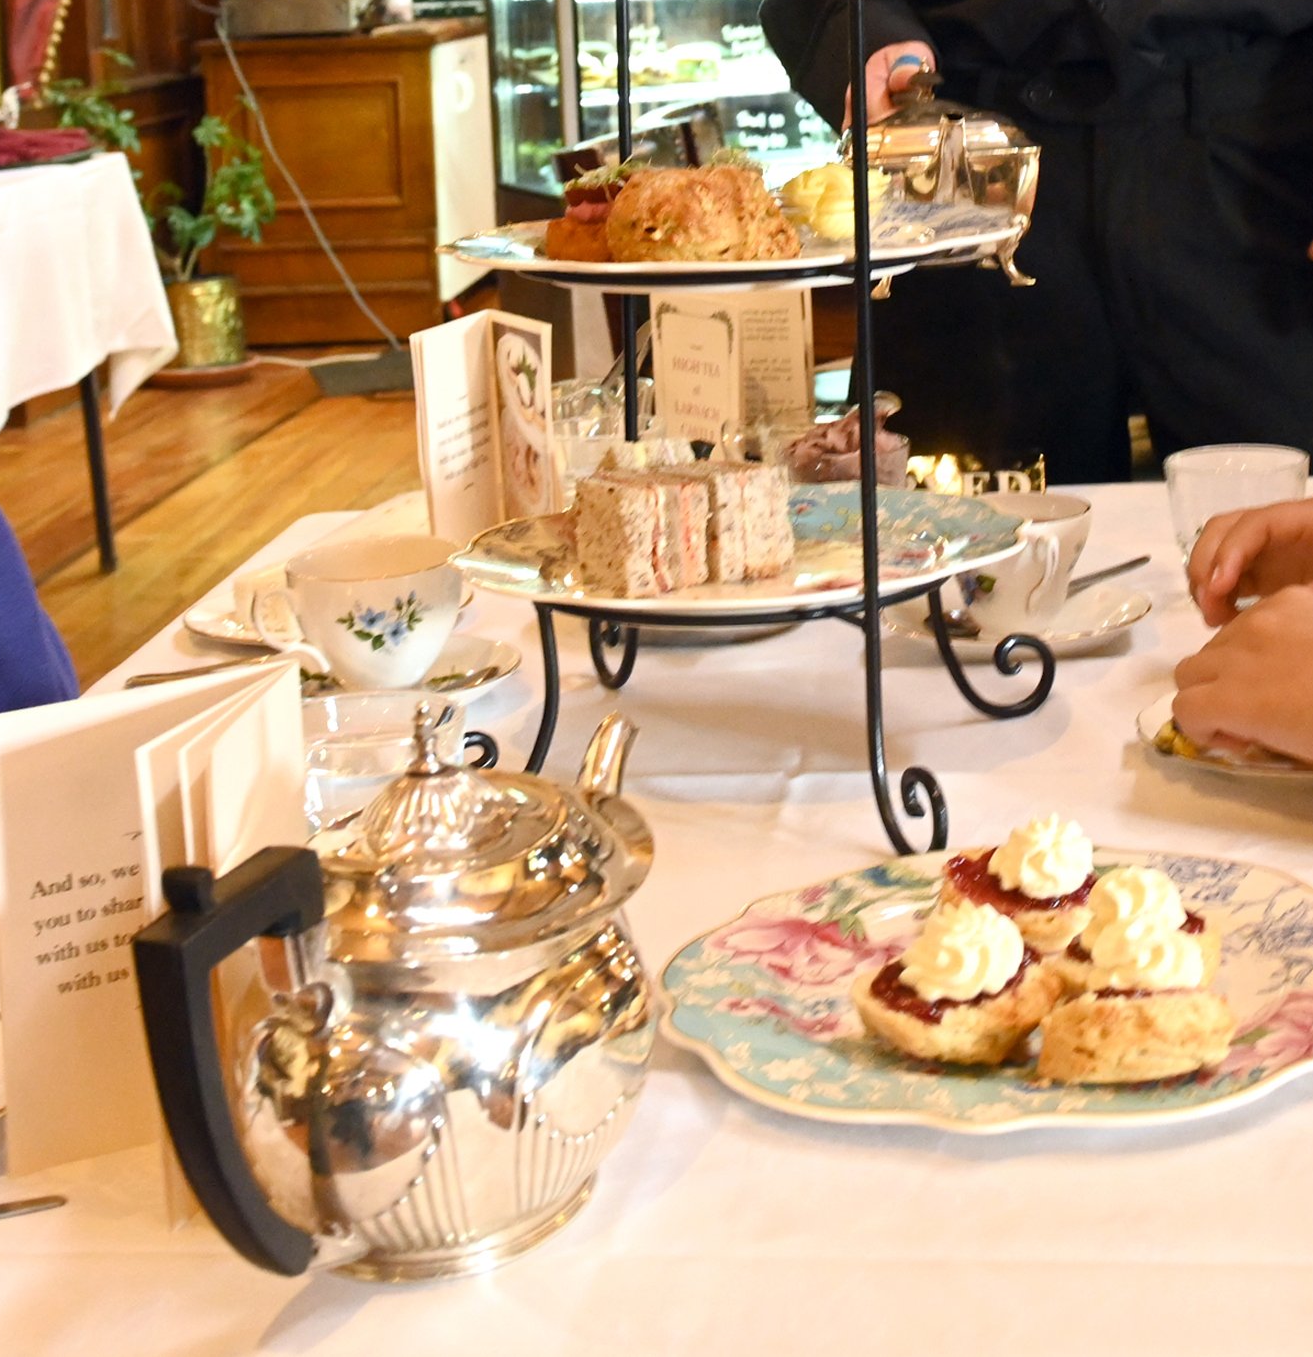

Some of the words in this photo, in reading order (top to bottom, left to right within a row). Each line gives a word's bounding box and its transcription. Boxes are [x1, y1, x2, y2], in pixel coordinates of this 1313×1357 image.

[30, 873, 73, 899] And
[78, 873, 106, 887] so,
[111, 864, 140, 879] we
[33, 913, 71, 937] you
[76, 907, 97, 923] to
[101, 896, 144, 917] shar
[36, 941, 80, 964] with
[85, 939, 109, 954] us
[57, 970, 101, 994] with
[107, 968, 130, 984] us
